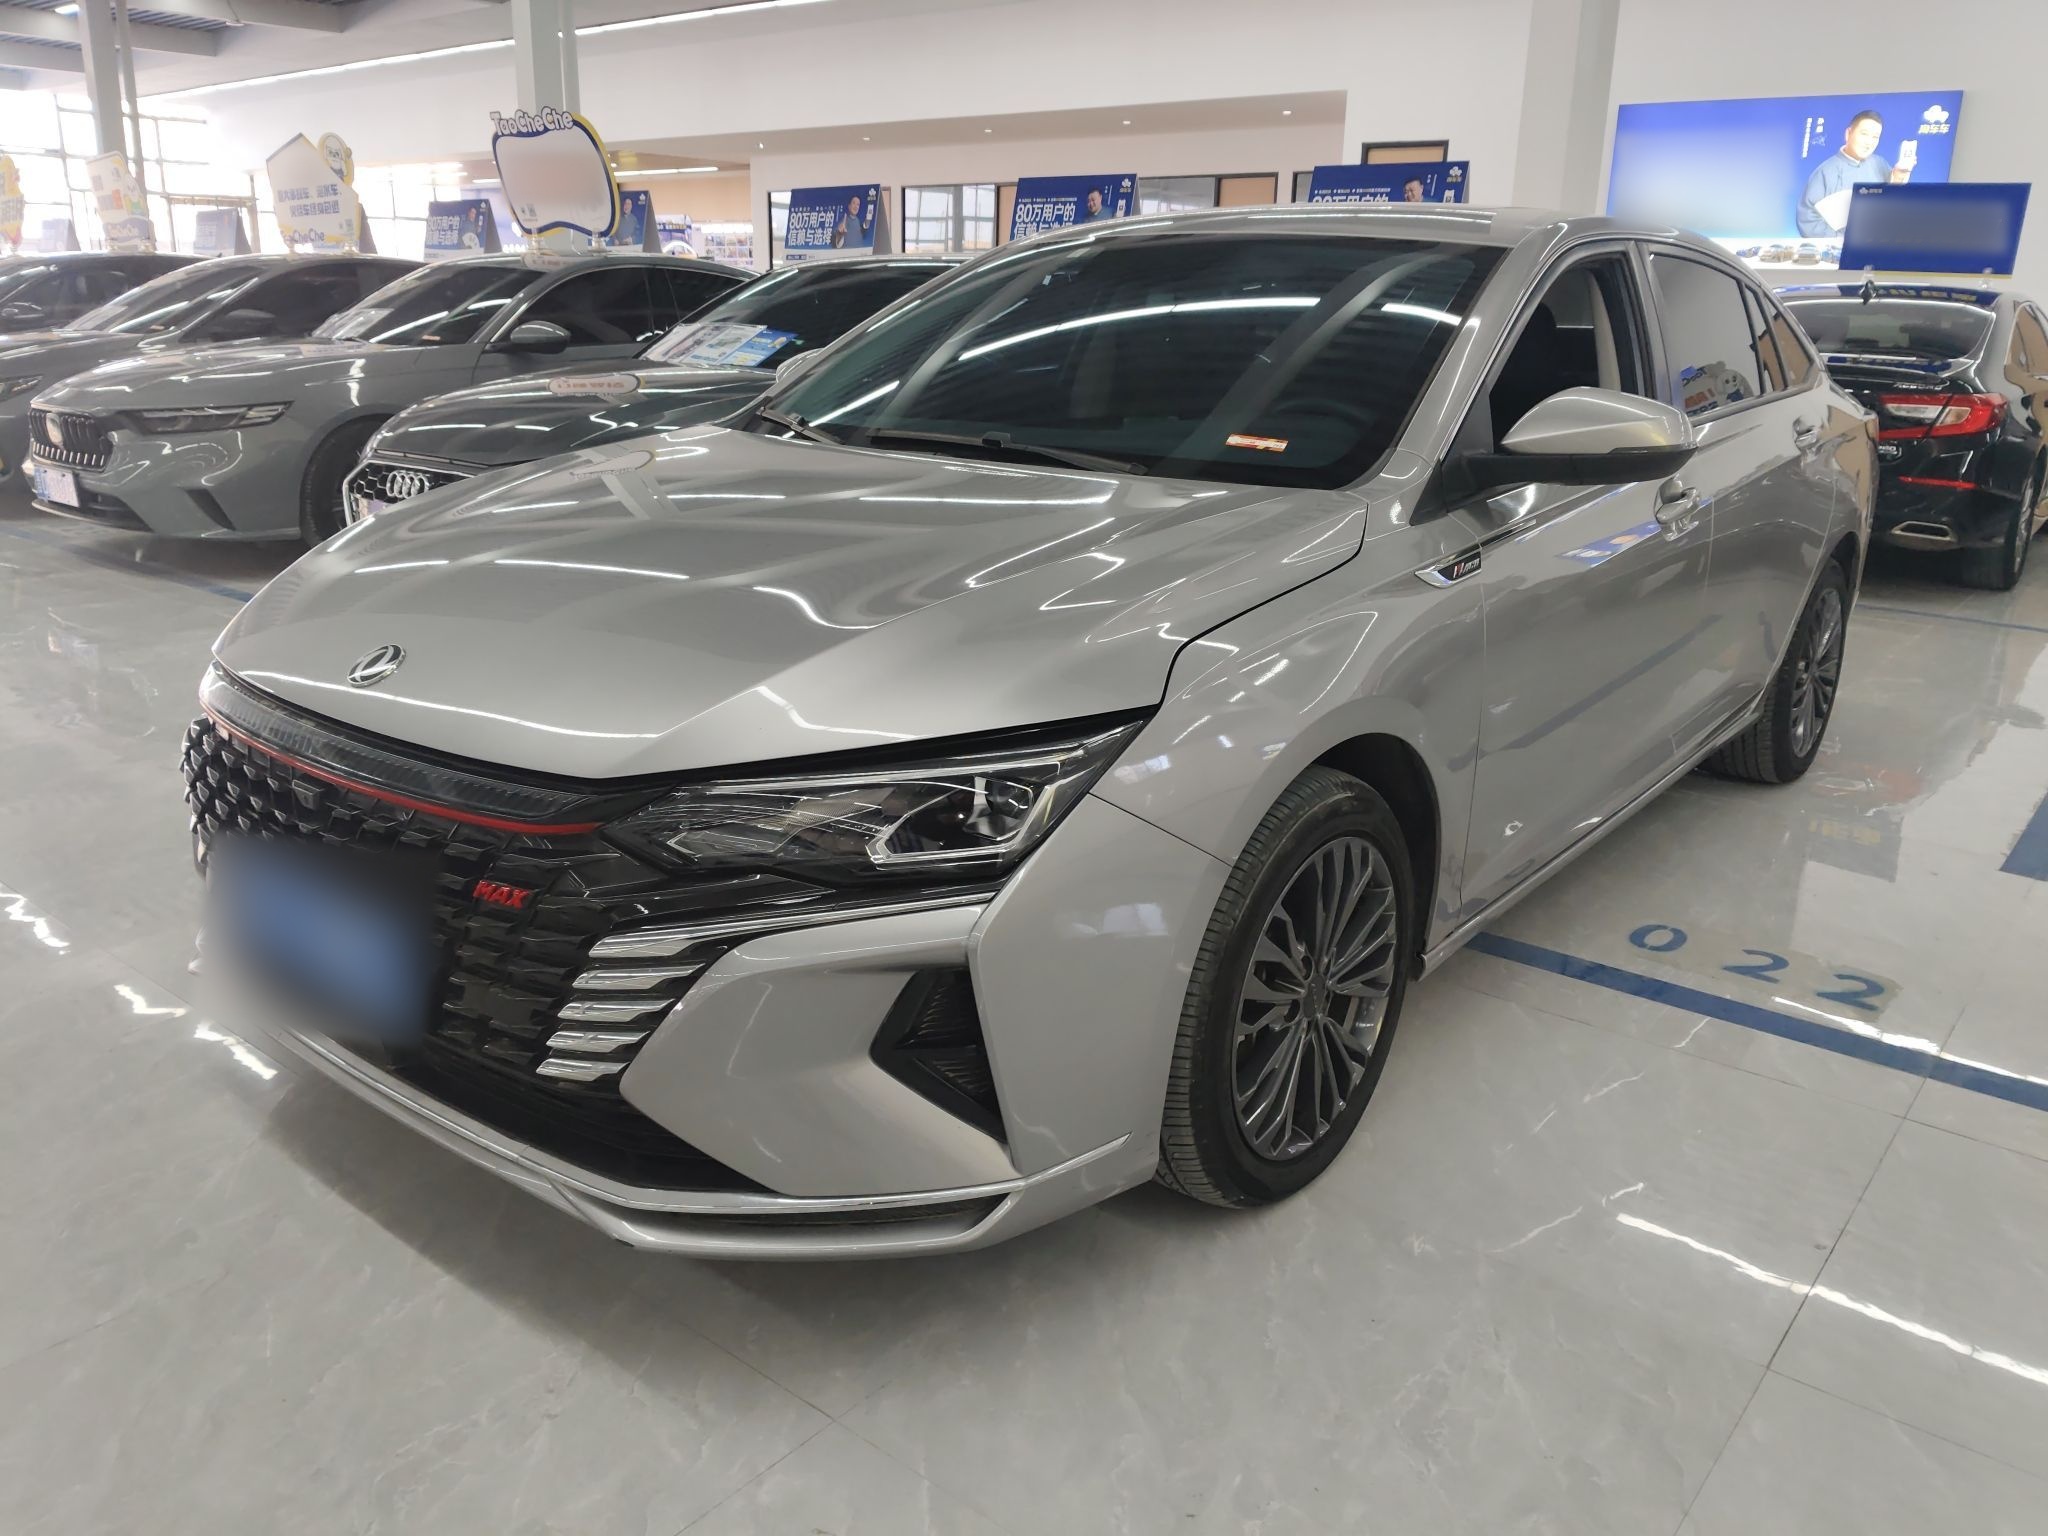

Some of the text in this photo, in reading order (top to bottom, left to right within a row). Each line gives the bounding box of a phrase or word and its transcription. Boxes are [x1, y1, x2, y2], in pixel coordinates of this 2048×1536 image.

[490, 106, 574, 136] TaoCheChe
[789, 210, 835, 230] 80万用户的
[1016, 202, 1076, 223] 80万用户的
[788, 227, 833, 246] 信赖与选择
[473, 880, 529, 909] MAX
[1629, 924, 1885, 1012] 022
